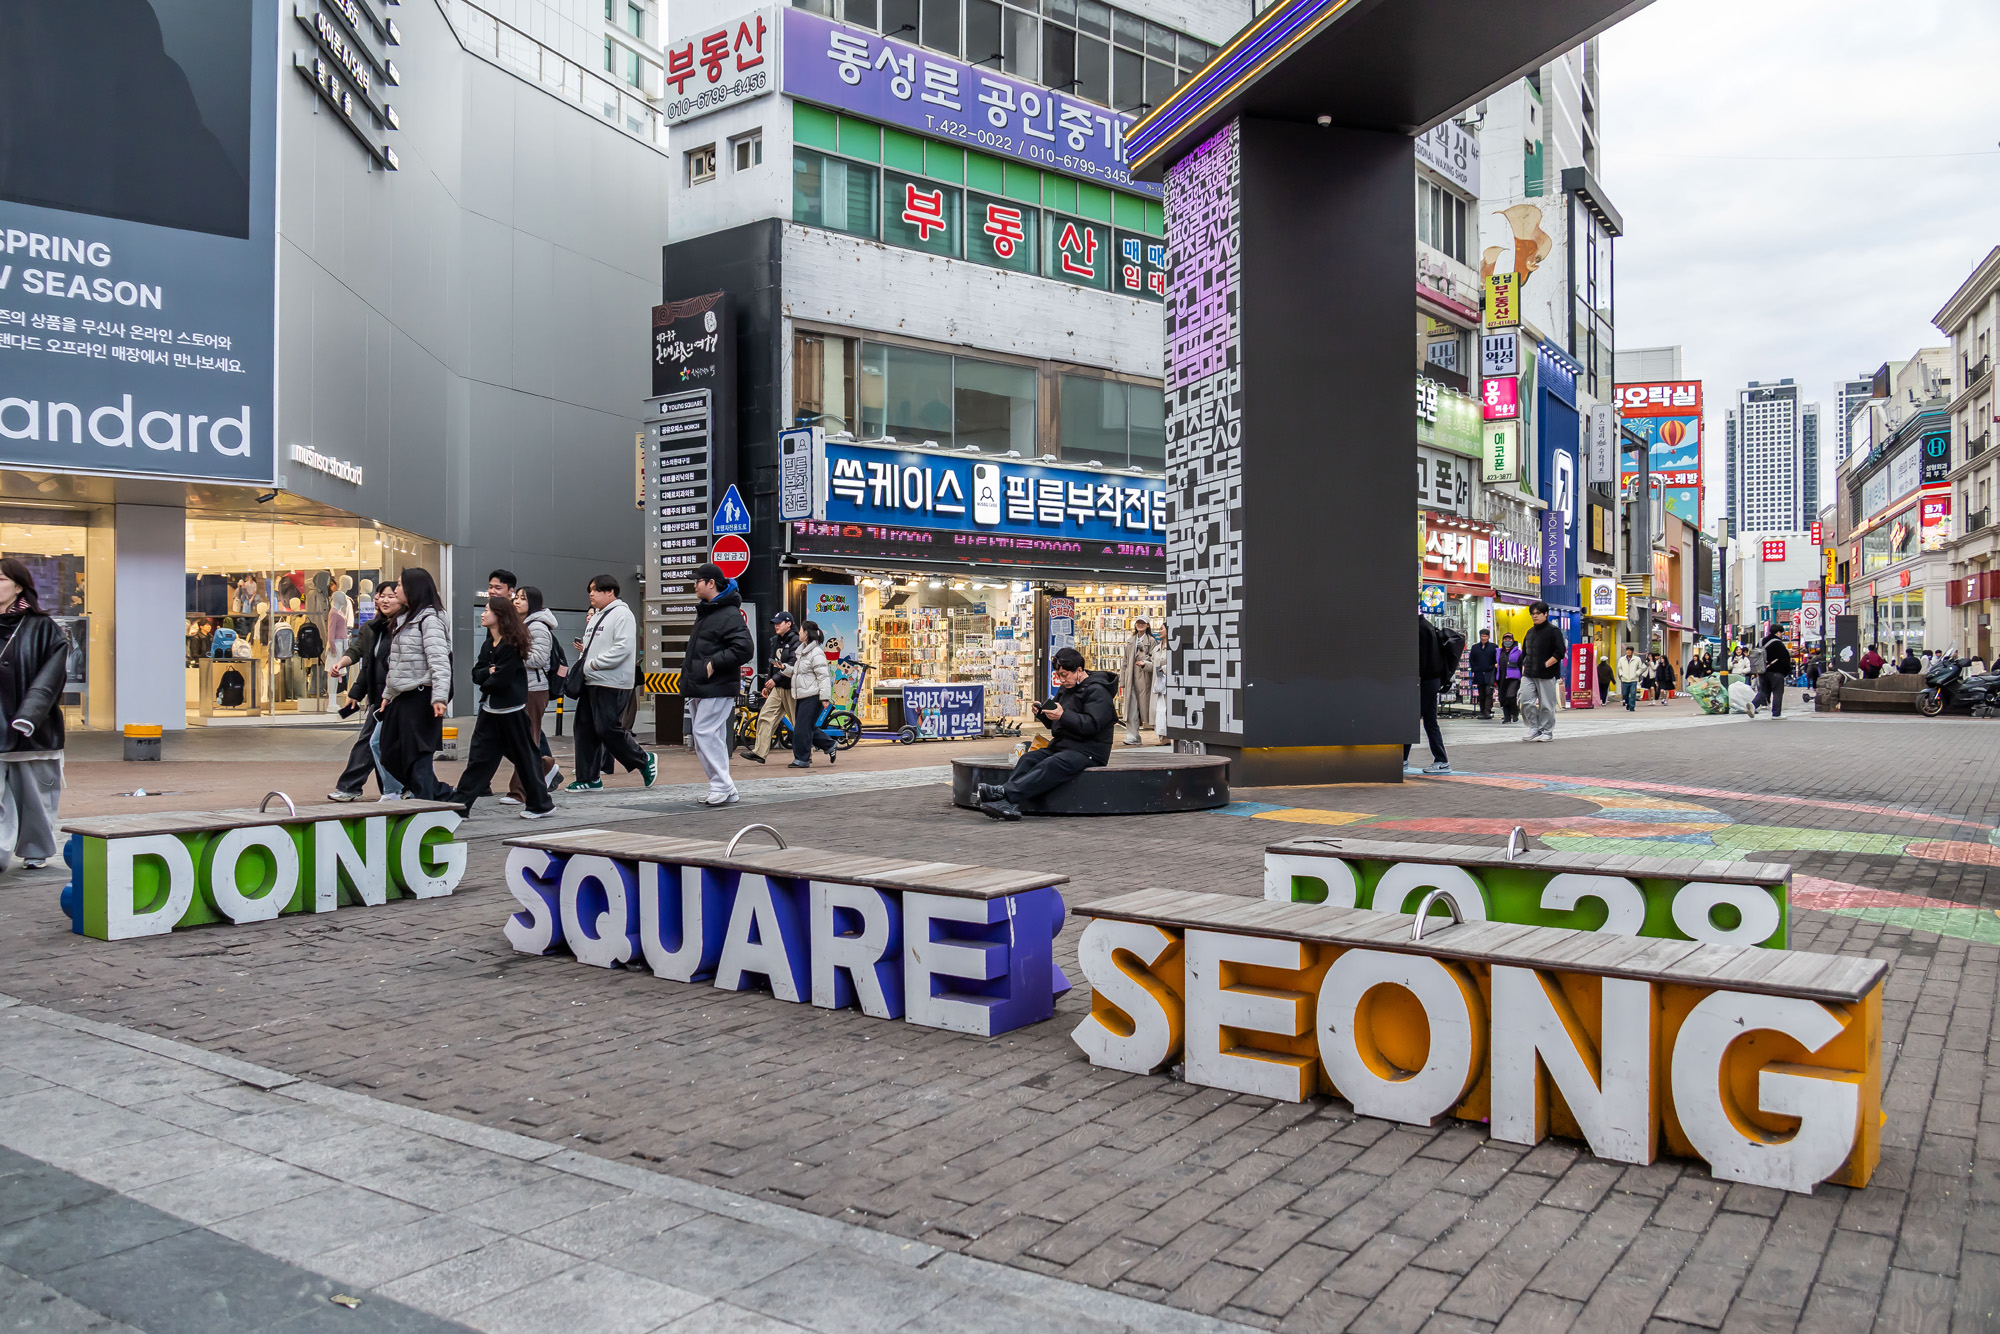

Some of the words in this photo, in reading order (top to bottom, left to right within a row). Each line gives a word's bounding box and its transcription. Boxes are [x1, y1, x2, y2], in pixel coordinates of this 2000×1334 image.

[667, 15, 767, 95] 부동산
[827, 30, 962, 112] 동성로
[667, 71, 767, 119] 010-6799-3456
[925, 114, 1012, 150] T.422-0022
[22, 268, 163, 310] SEASON
[1494, 284, 1510, 319] 부동산
[30, 313, 77, 333] 상품을
[81, 319, 125, 339] 무신사
[129, 325, 173, 345] 온라인
[177, 332, 232, 351] 스토어와
[46, 339, 107, 360] 오프라인
[111, 345, 169, 366] 매장에서
[173, 353, 246, 374] 만나보세요.
[1485, 381, 1500, 406] 홍
[292, 444, 329, 473] musinsa
[329, 456, 363, 486] standard
[1494, 432, 1505, 471] 에코폰
[825, 458, 966, 514] 쓱케이스
[716, 523, 747, 532] 보행자전용도로
[1548, 512, 1558, 547] HOLIKA
[716, 552, 746, 561] 진입금지
[1548, 549, 1558, 585] HOLIKA
[820, 594, 846, 604] CRAYON
[905, 690, 942, 710] 강아지
[947, 689, 973, 707] 간식
[920, 714, 948, 735] 4개
[951, 711, 982, 735] 만원
[107, 810, 468, 942] DONG
[503, 847, 1000, 1038] SQUARE
[1071, 918, 1865, 1194] SEONG
